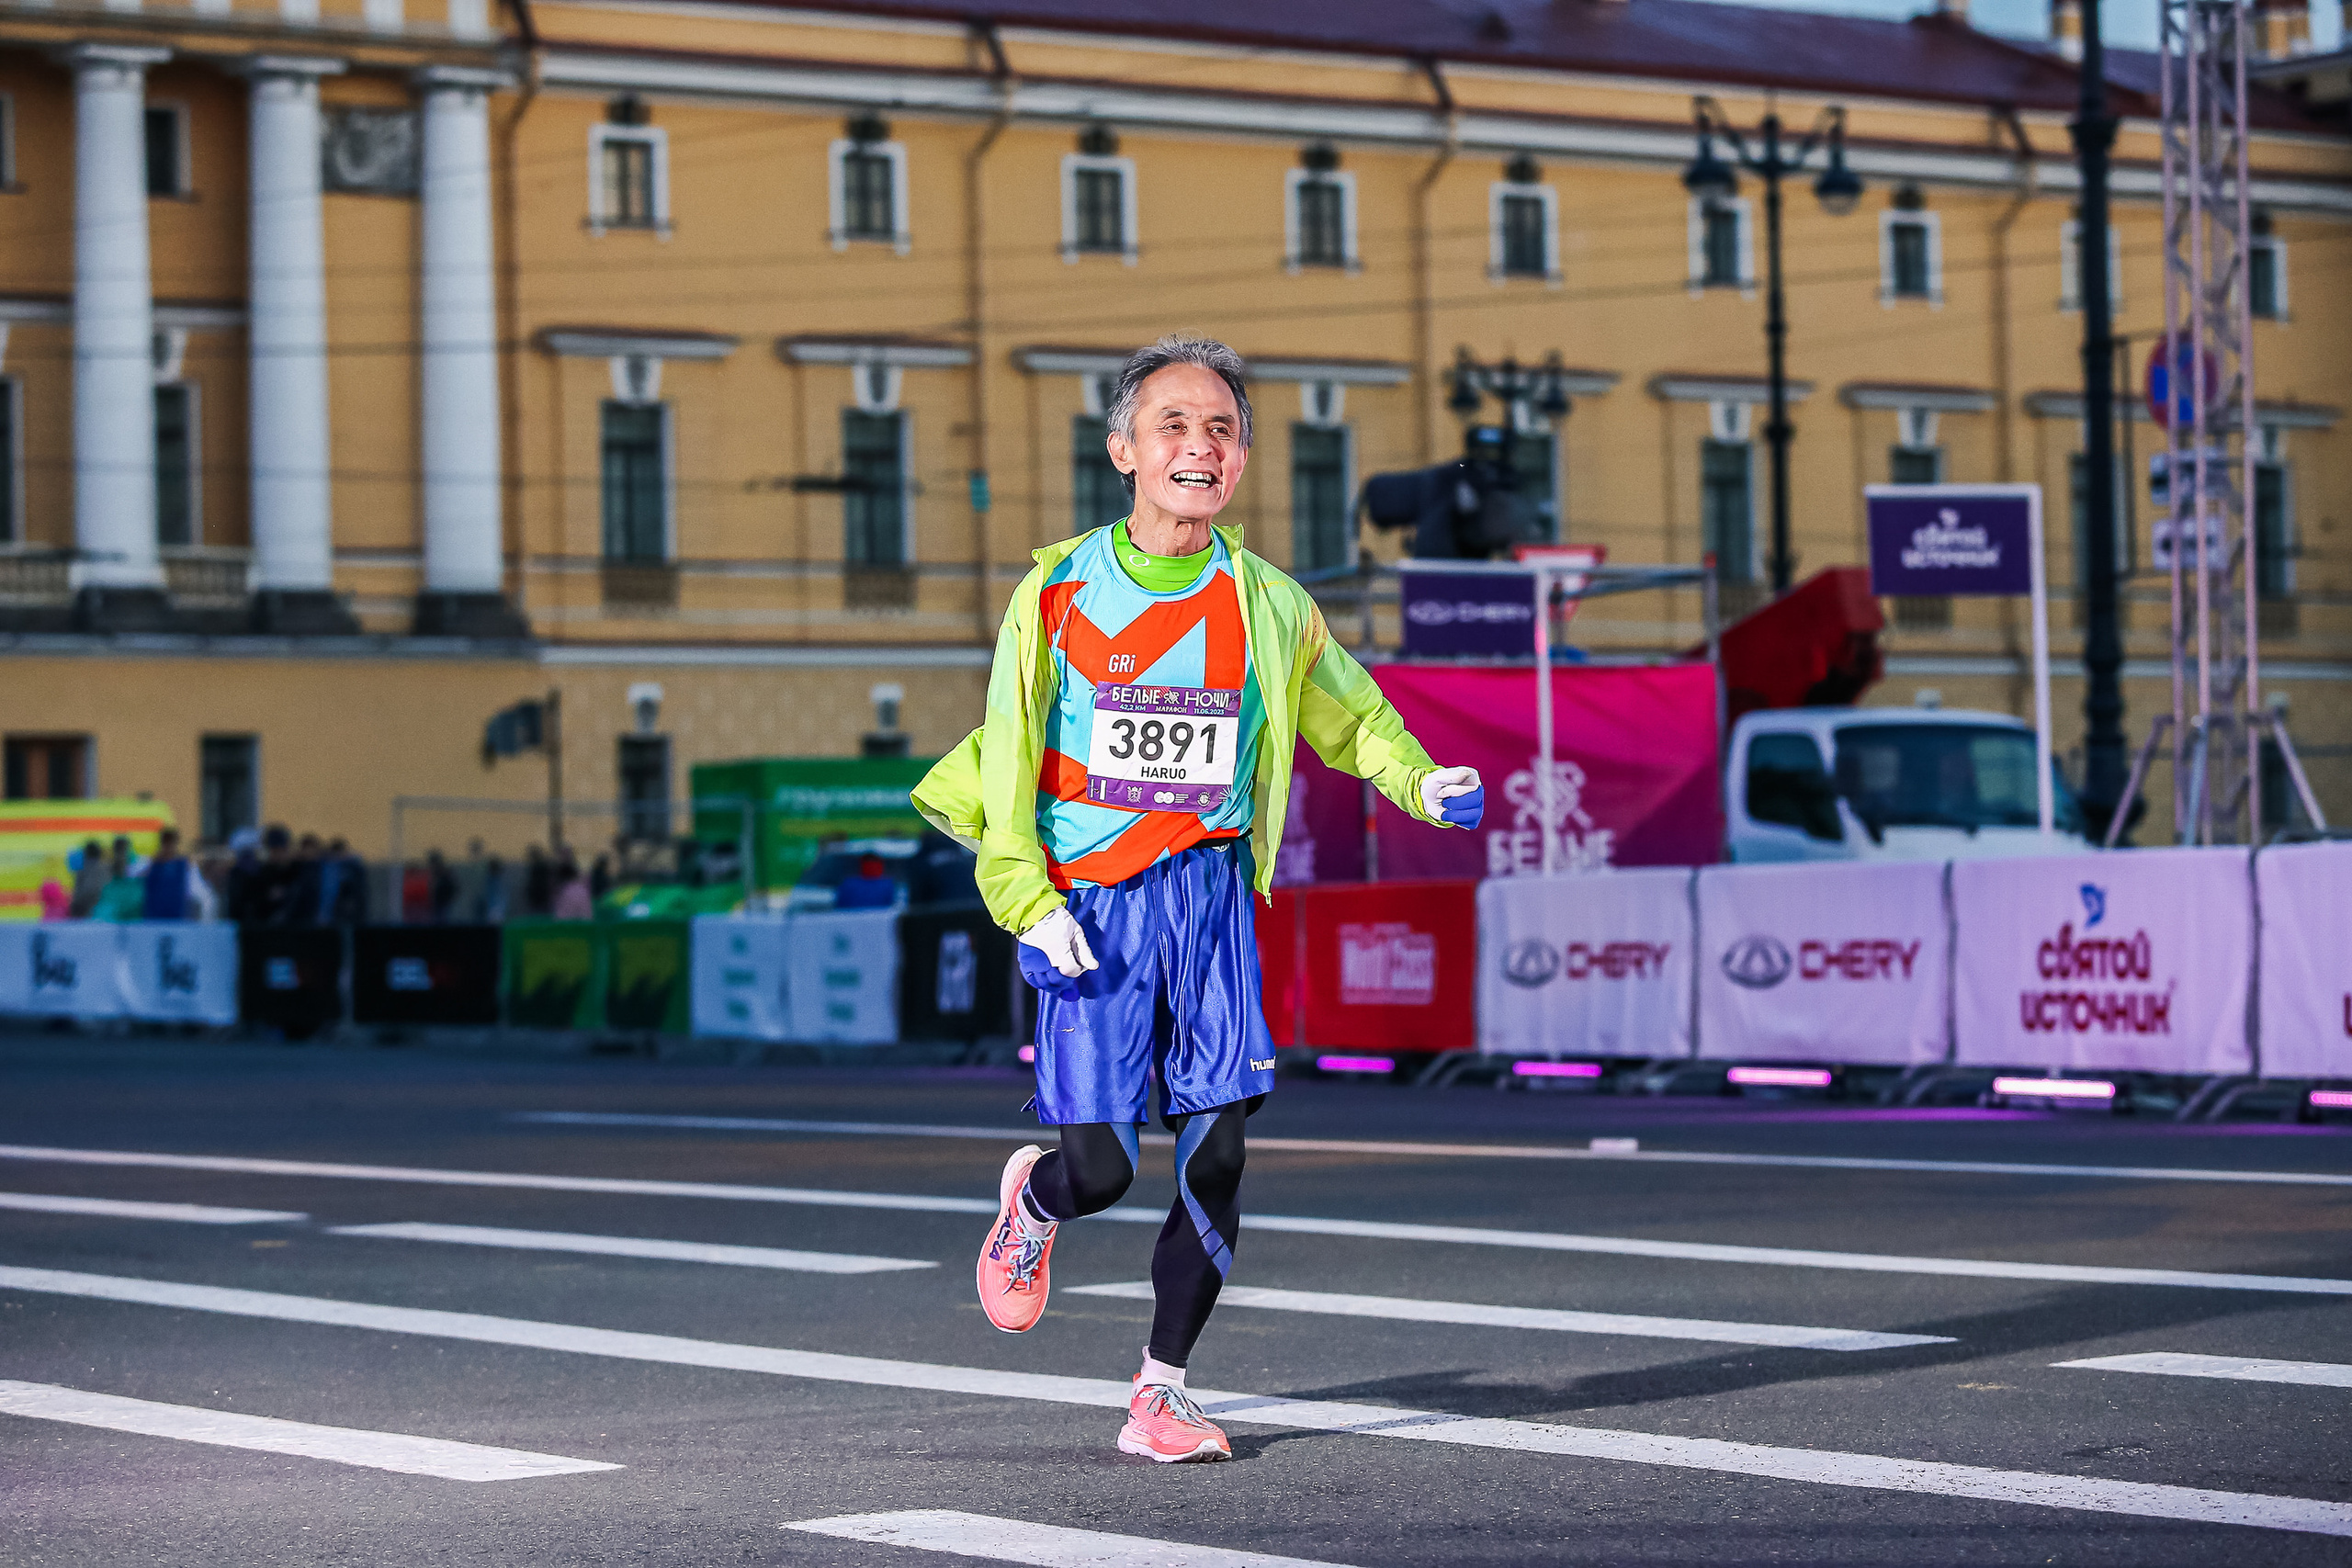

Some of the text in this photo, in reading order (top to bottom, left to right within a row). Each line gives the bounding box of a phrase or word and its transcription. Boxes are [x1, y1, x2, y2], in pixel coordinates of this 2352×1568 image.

[1108, 653, 1136, 673] GRi
[1112, 686, 1230, 708] БЕЛЫЕ НОЧИ
[1109, 718, 1216, 763] 3891
[1567, 942, 1669, 980] CHERY
[1799, 941, 1919, 981] CHERY
